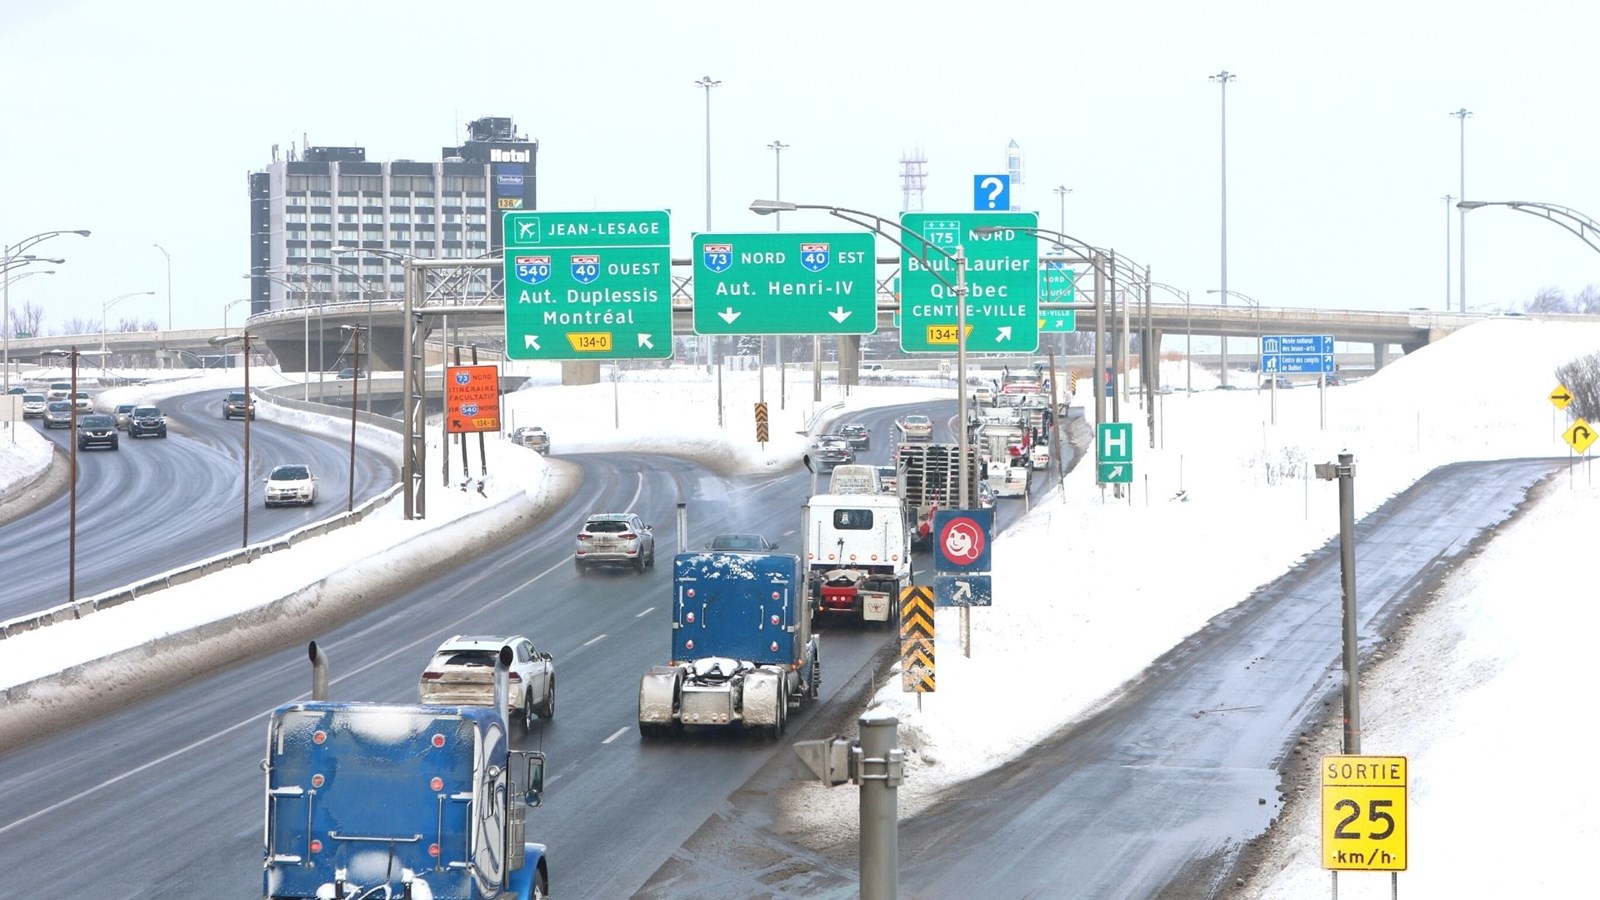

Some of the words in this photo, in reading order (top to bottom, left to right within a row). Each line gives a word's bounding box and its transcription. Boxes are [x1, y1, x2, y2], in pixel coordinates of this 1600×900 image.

[490, 149, 530, 163] Hotel
[548, 222, 660, 236] JEAN-LESAGE
[929, 232, 953, 244] 175
[710, 253, 728, 265] 73
[741, 252, 786, 265] NORD
[805, 253, 826, 264] 40
[838, 251, 865, 264] EST
[908, 256, 955, 272] Boul.
[964, 255, 1030, 272] Laurier
[519, 265, 548, 277] 540
[575, 265, 596, 276] 40
[607, 262, 661, 276] OUEST
[715, 281, 757, 296] Aut.
[768, 279, 854, 296] Henri-IV
[518, 289, 557, 304] Aut.
[567, 287, 658, 306] Duplessis
[543, 309, 634, 325] Montréal
[458, 375, 468, 383] 73
[1104, 428, 1126, 457] H
[1328, 763, 1401, 780] SORTIE
[1333, 798, 1396, 841] 25
[1337, 848, 1392, 866] km/h
